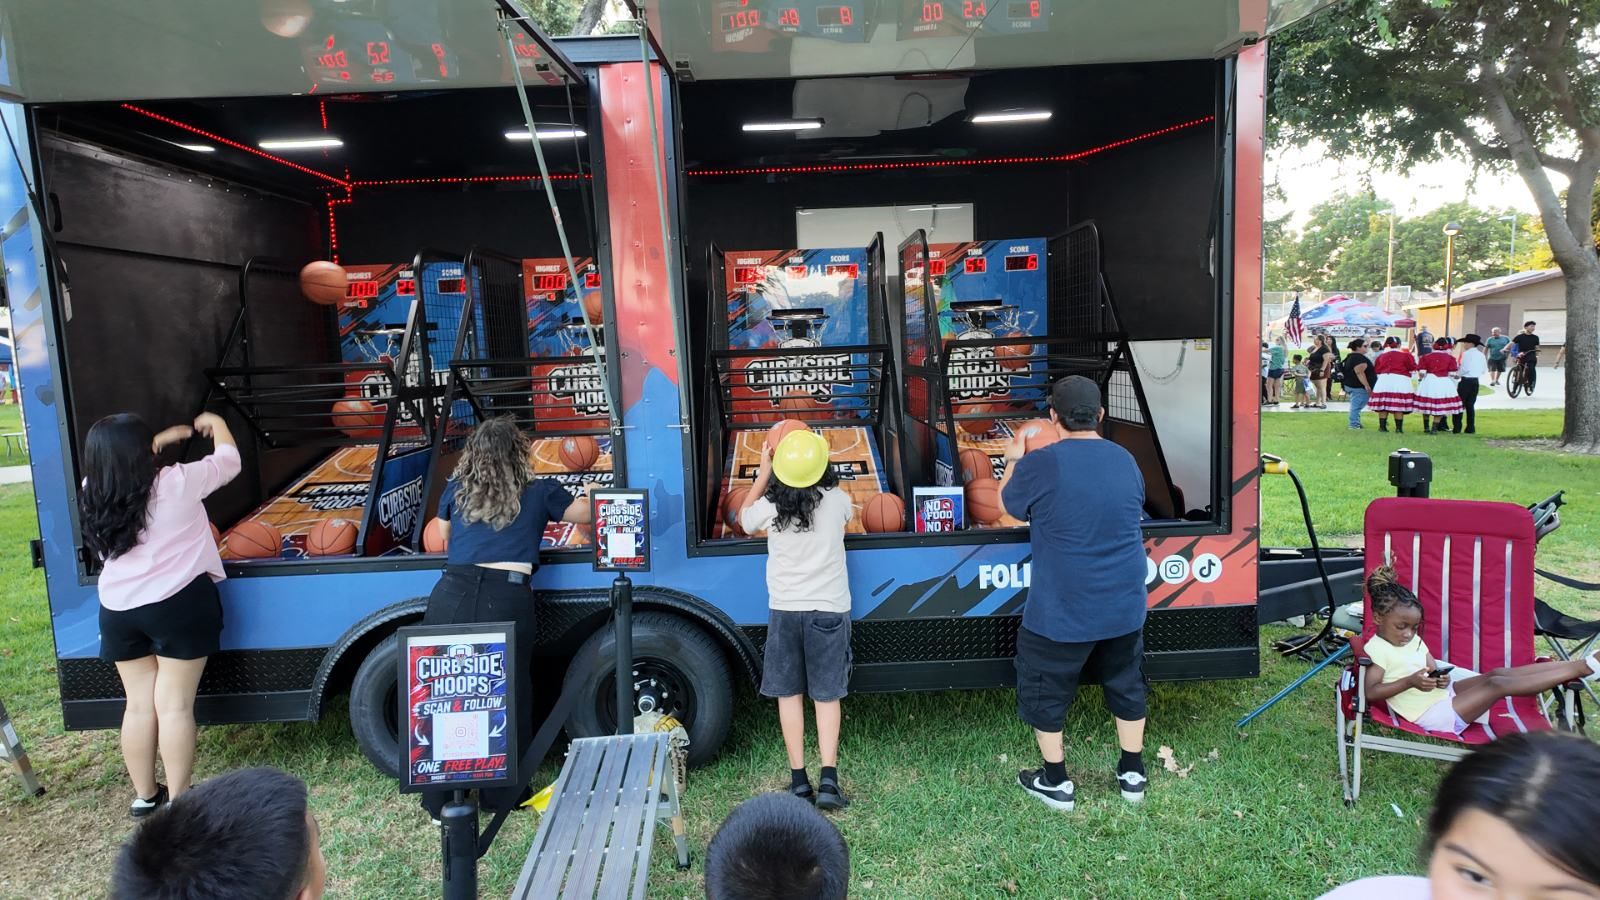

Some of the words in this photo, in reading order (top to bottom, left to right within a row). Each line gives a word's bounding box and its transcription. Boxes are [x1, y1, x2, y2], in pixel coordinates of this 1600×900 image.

[965, 258, 985, 272] 54
[351, 281, 377, 296] 100
[540, 275, 566, 290] 100
[949, 376, 1008, 397] HOOPS
[381, 481, 422, 522] CURBSIDE
[925, 501, 940, 511] NO
[393, 507, 418, 537] HOOPS
[608, 515, 635, 525] HOOPS
[927, 510, 952, 520] FOOD
[926, 521, 941, 532] NO
[979, 563, 1032, 589] FOLL
[434, 676, 489, 696] HOOPS
[423, 701, 451, 715] SCAN
[464, 697, 502, 711] FOLLOW
[417, 761, 442, 773] ONE
[444, 759, 471, 772] FREE
[474, 757, 506, 769] PLAY!
